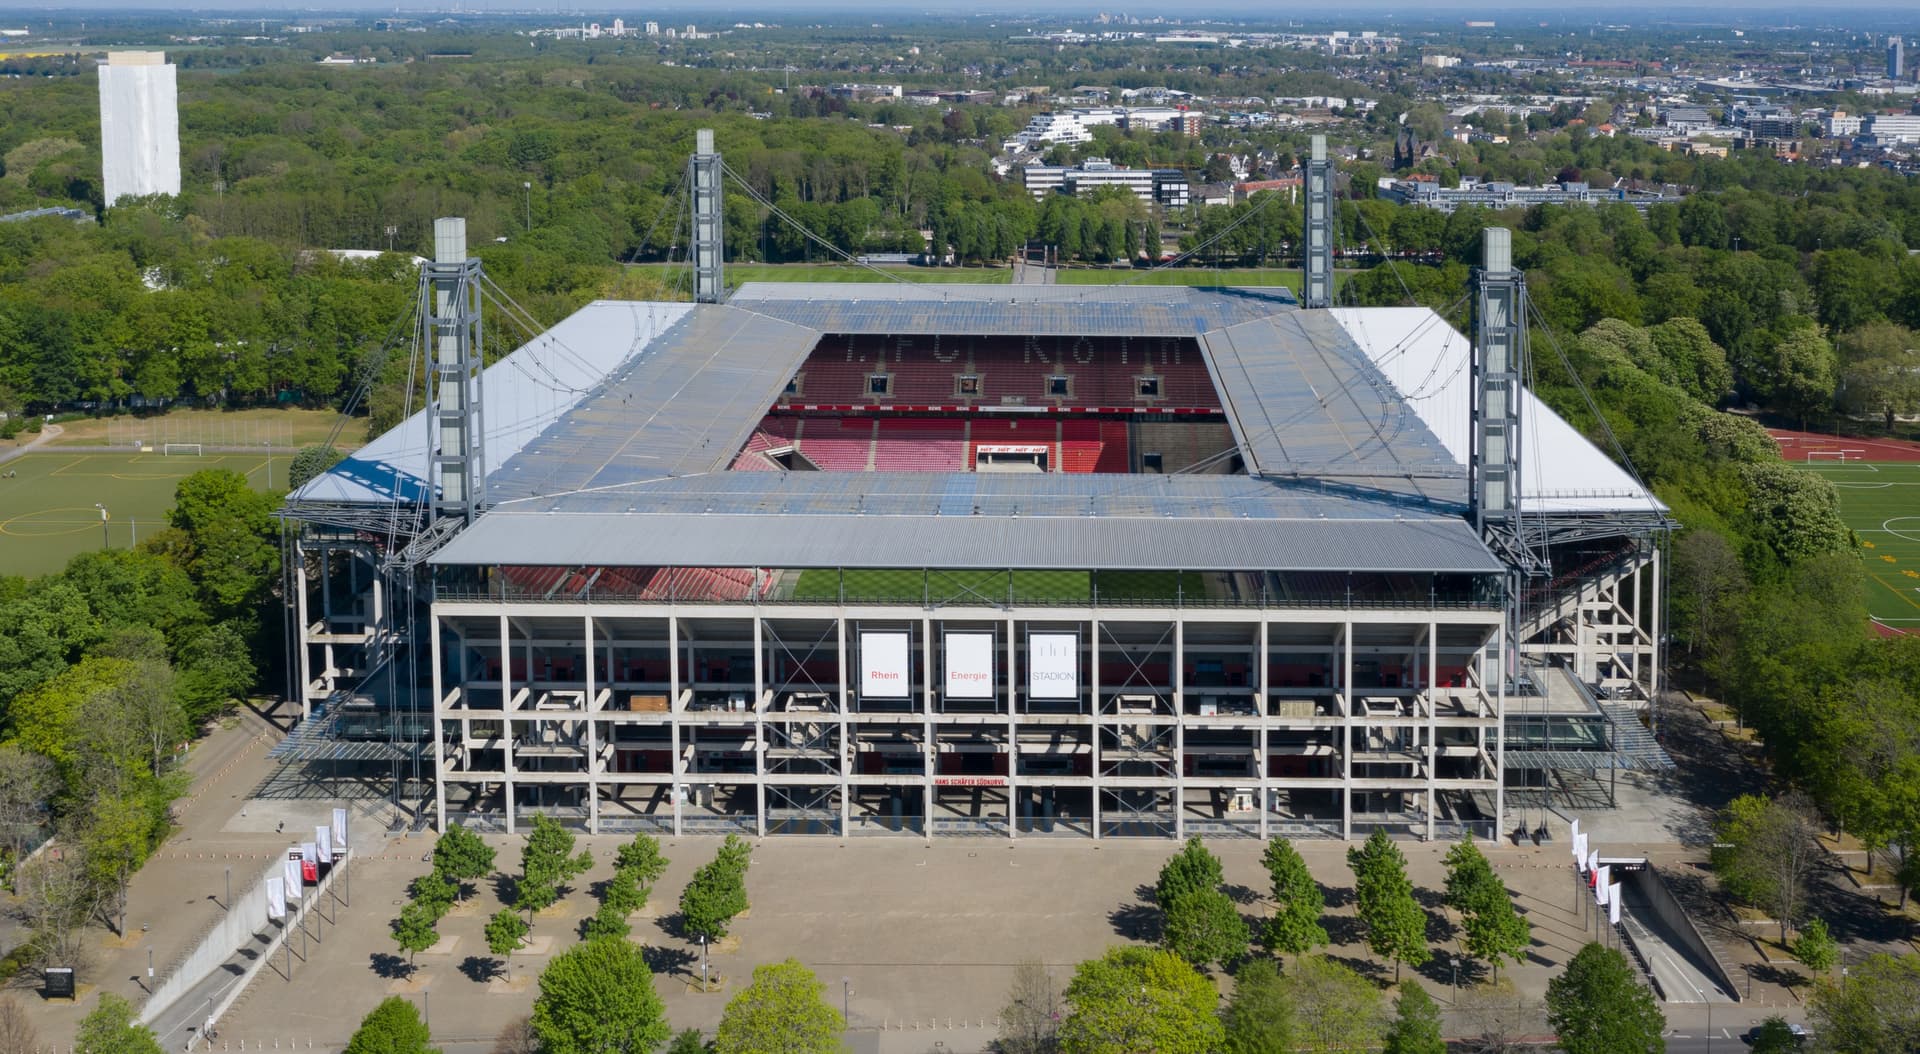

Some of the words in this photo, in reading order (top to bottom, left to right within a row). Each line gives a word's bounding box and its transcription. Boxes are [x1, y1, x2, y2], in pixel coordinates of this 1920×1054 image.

[871, 671, 899, 680] Rhein
[950, 671, 988, 682] Energie
[1032, 671, 1075, 681] STADION
